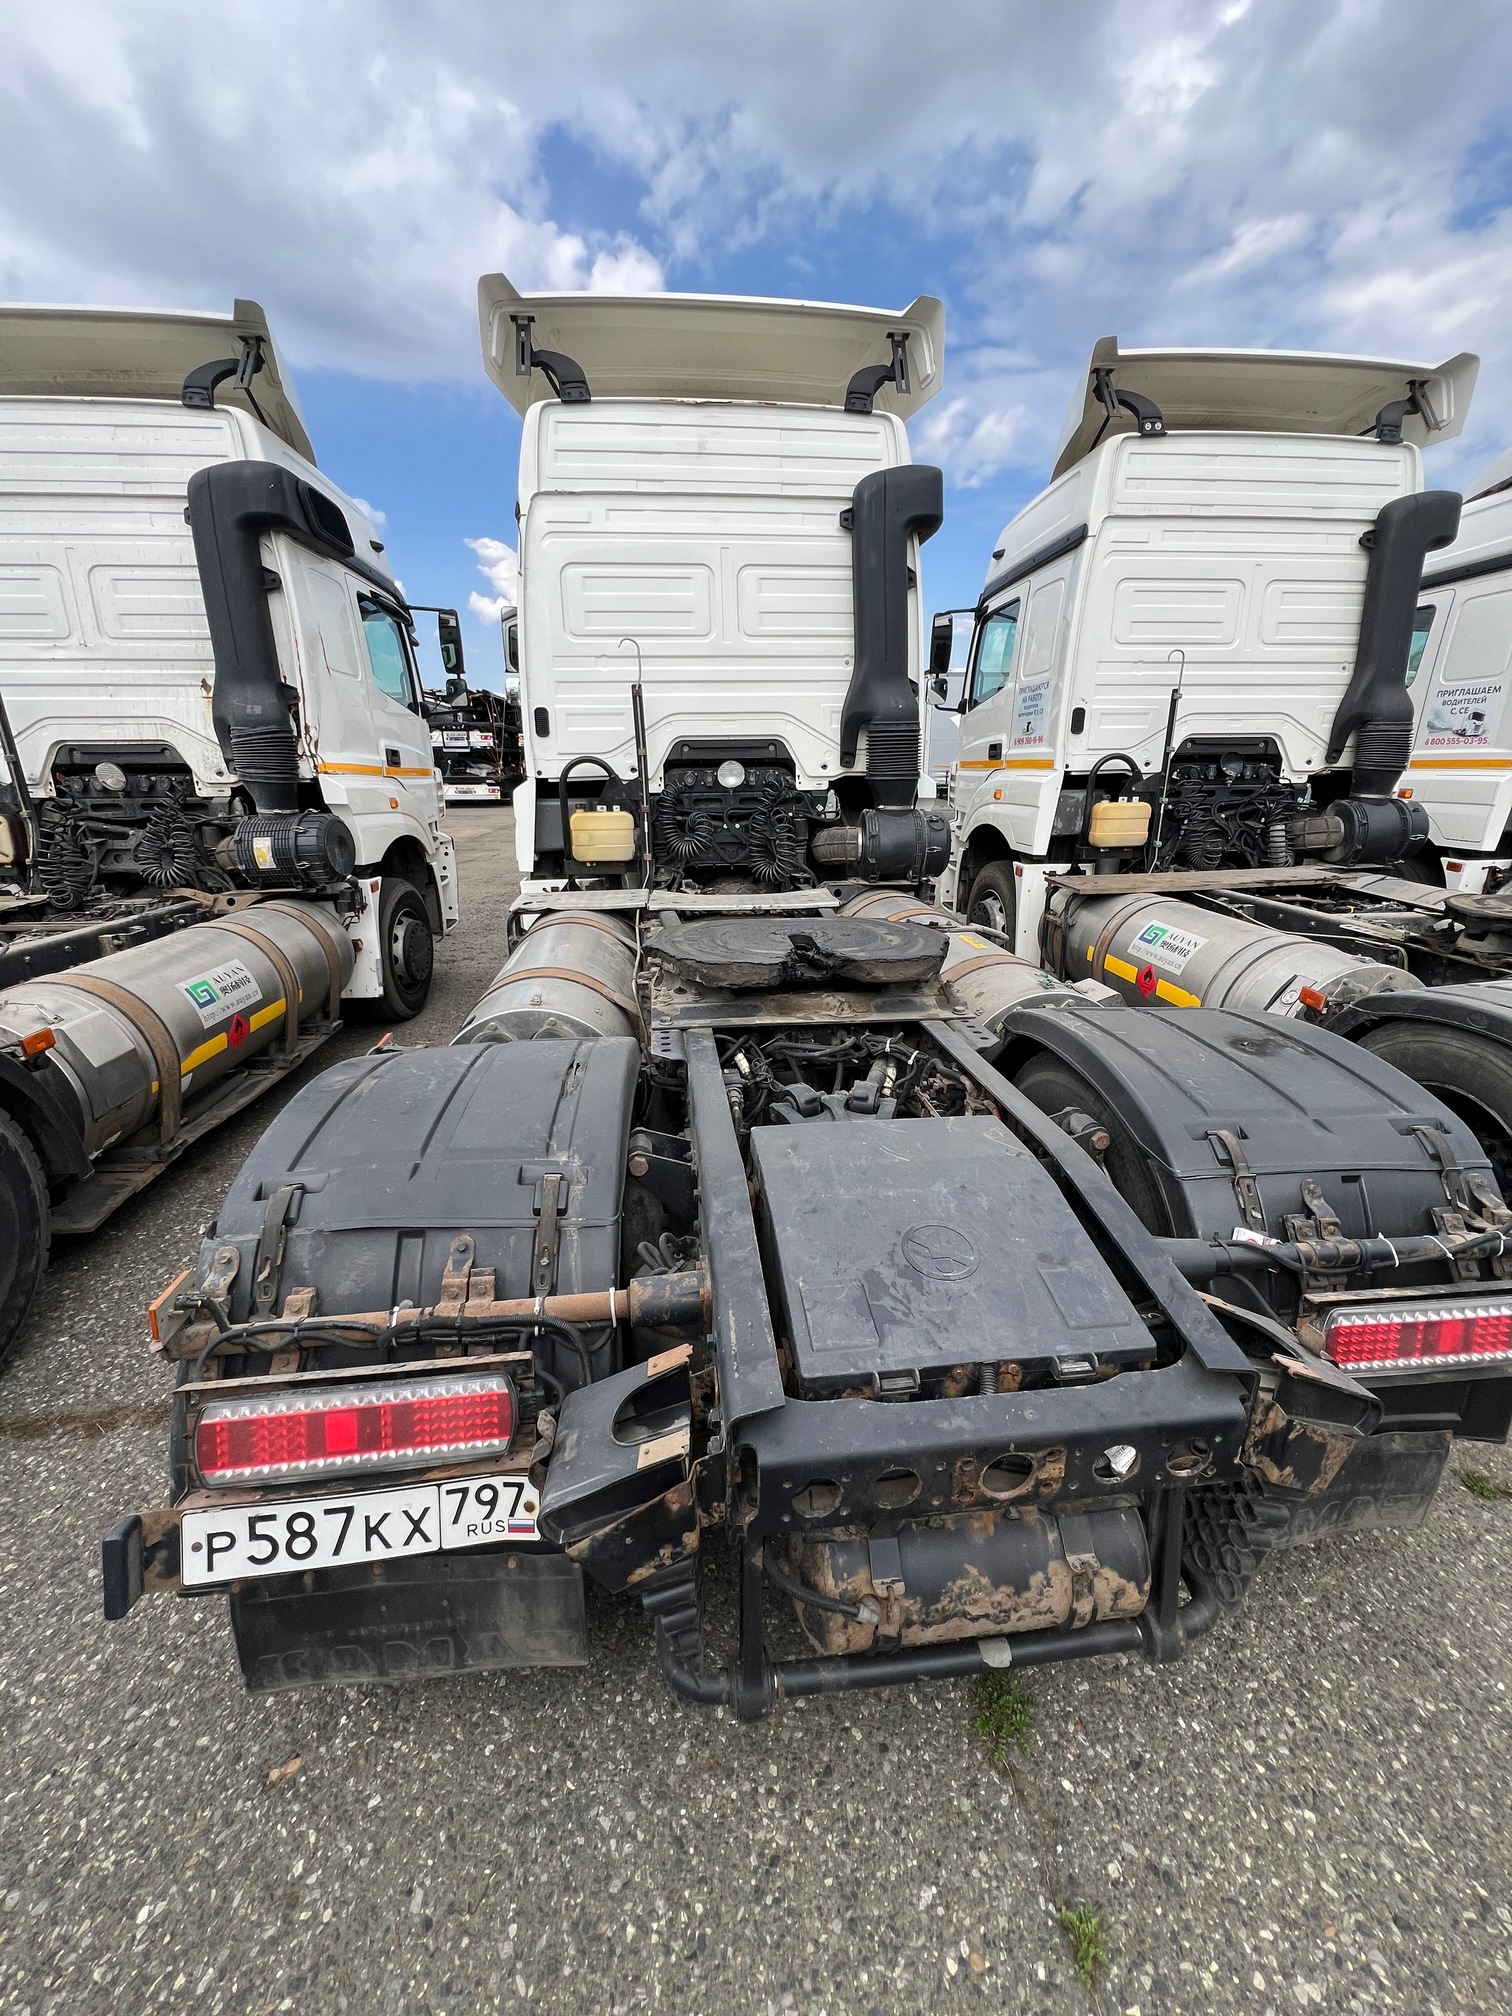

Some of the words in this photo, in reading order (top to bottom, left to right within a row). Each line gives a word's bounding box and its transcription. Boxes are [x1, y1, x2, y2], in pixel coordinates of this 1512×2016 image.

[1436, 685, 1502, 698] ПРИГЛАШАЕМ
[1442, 695, 1487, 707] ВОДИТЕЛЕЙ
[1430, 738, 1446, 746] 800
[1446, 736, 1489, 745] 555-03-95
[1168, 933, 1200, 949] AUYAN
[212, 965, 245, 985] AUYAN
[445, 1481, 526, 1526] 797
[466, 1519, 506, 1538] RUS
